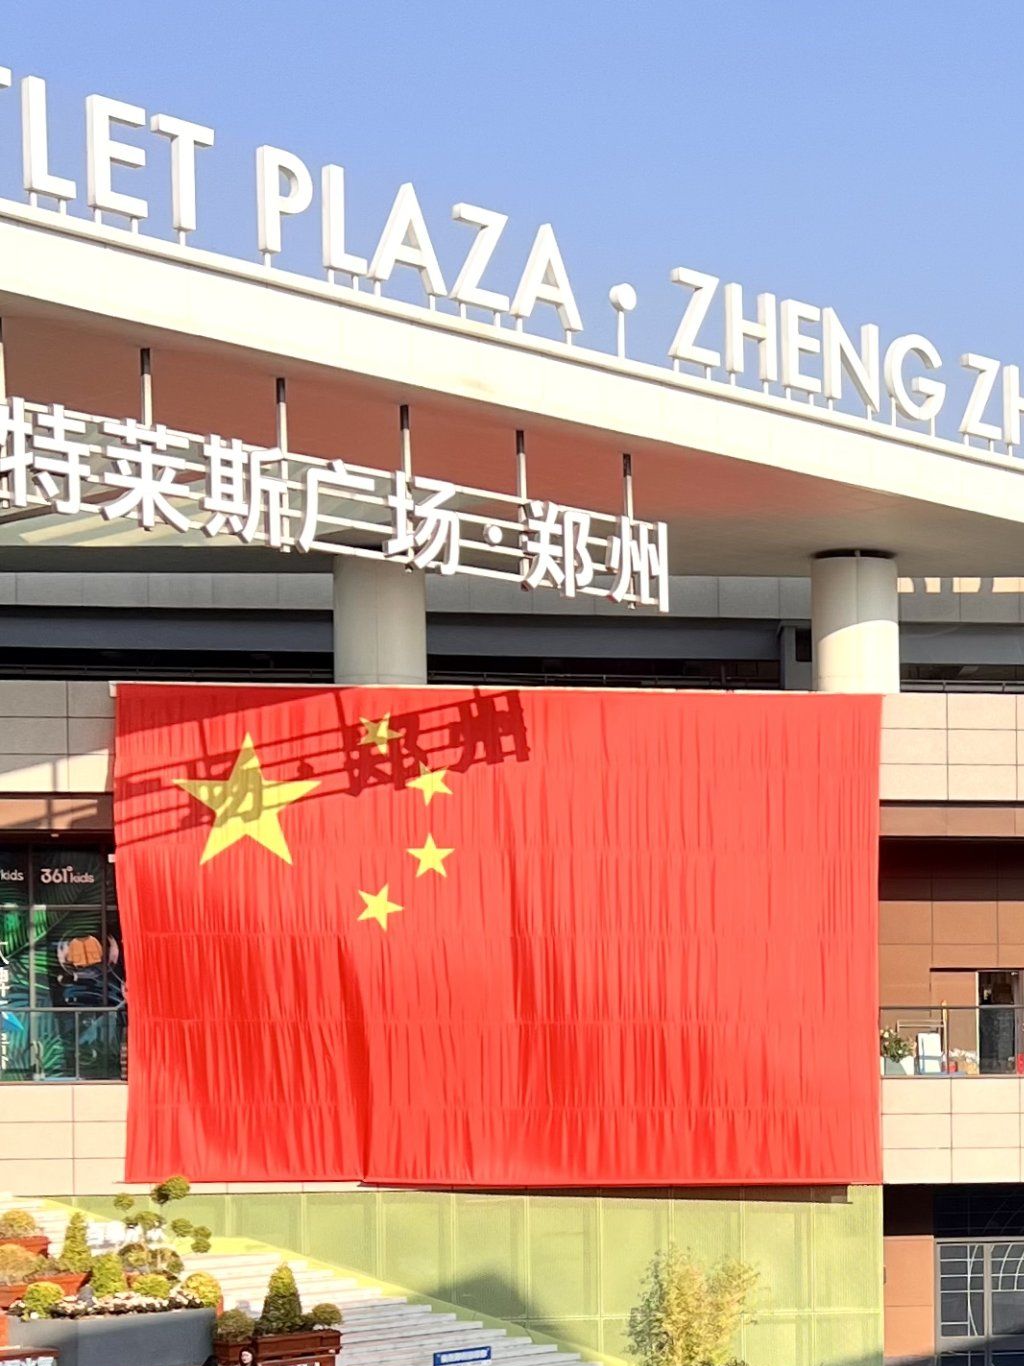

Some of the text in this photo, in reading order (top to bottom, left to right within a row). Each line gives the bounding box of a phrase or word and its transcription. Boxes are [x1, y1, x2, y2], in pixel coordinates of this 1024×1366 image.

[0, 66, 215, 231] LET
[256, 145, 583, 332] PLAZA
[668, 267, 947, 421] ZHENG
